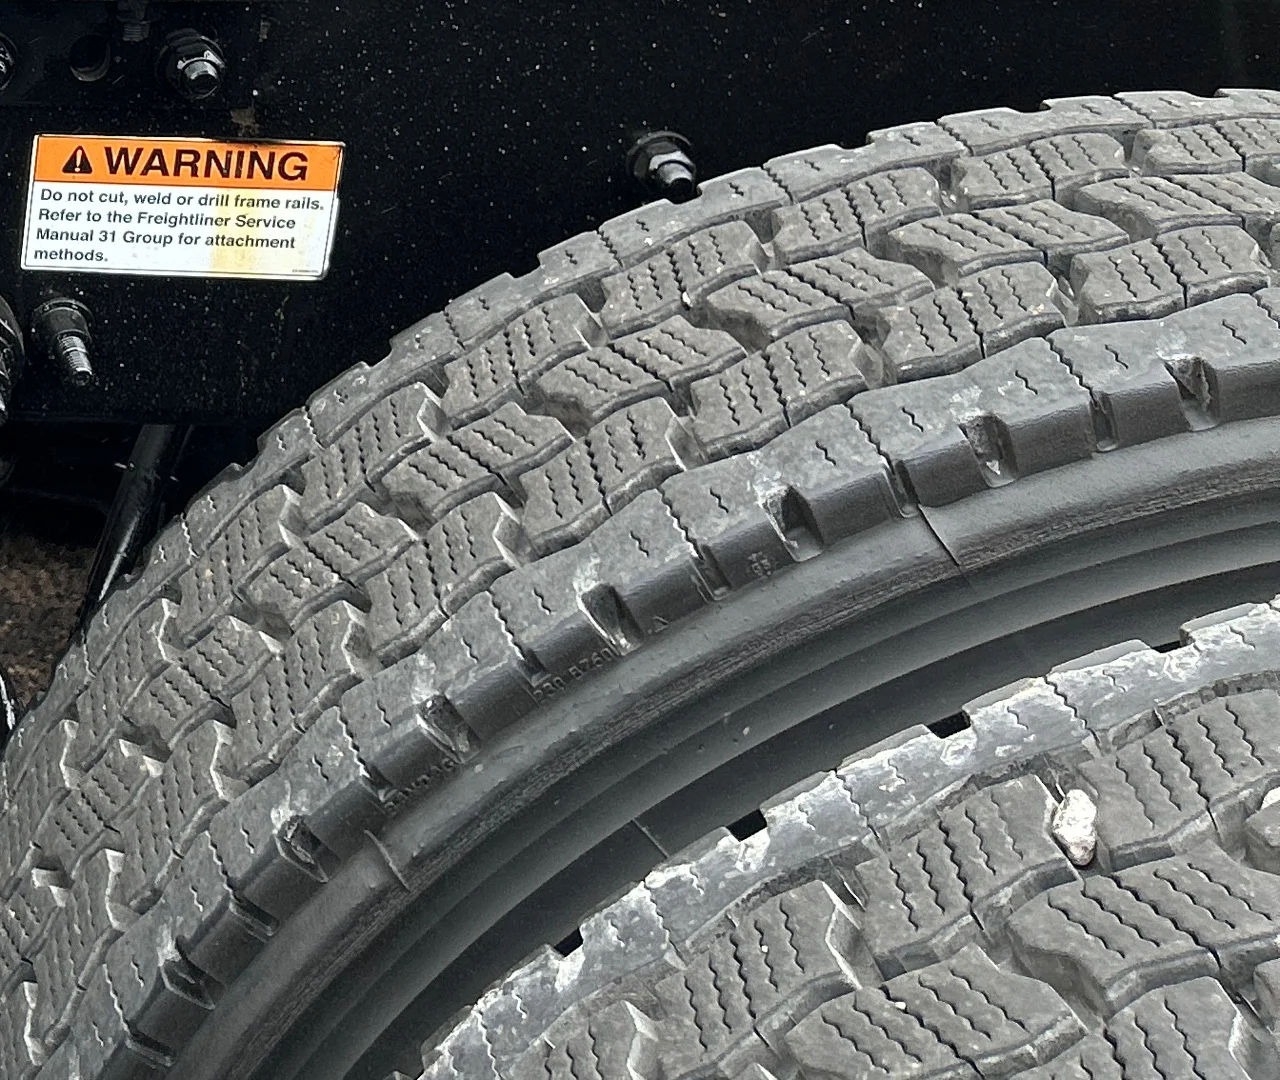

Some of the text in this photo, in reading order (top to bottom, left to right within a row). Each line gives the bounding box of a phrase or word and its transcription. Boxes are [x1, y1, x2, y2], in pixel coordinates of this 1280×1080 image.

[104, 145, 309, 181] WARNING
[40, 188, 324, 211] Do not cut, weld or drill frame rails.
[38, 208, 296, 229] Refer to the Freightliner Service
[36, 228, 296, 249] Manual 31 Group for attachment
[33, 248, 108, 262] methods.
